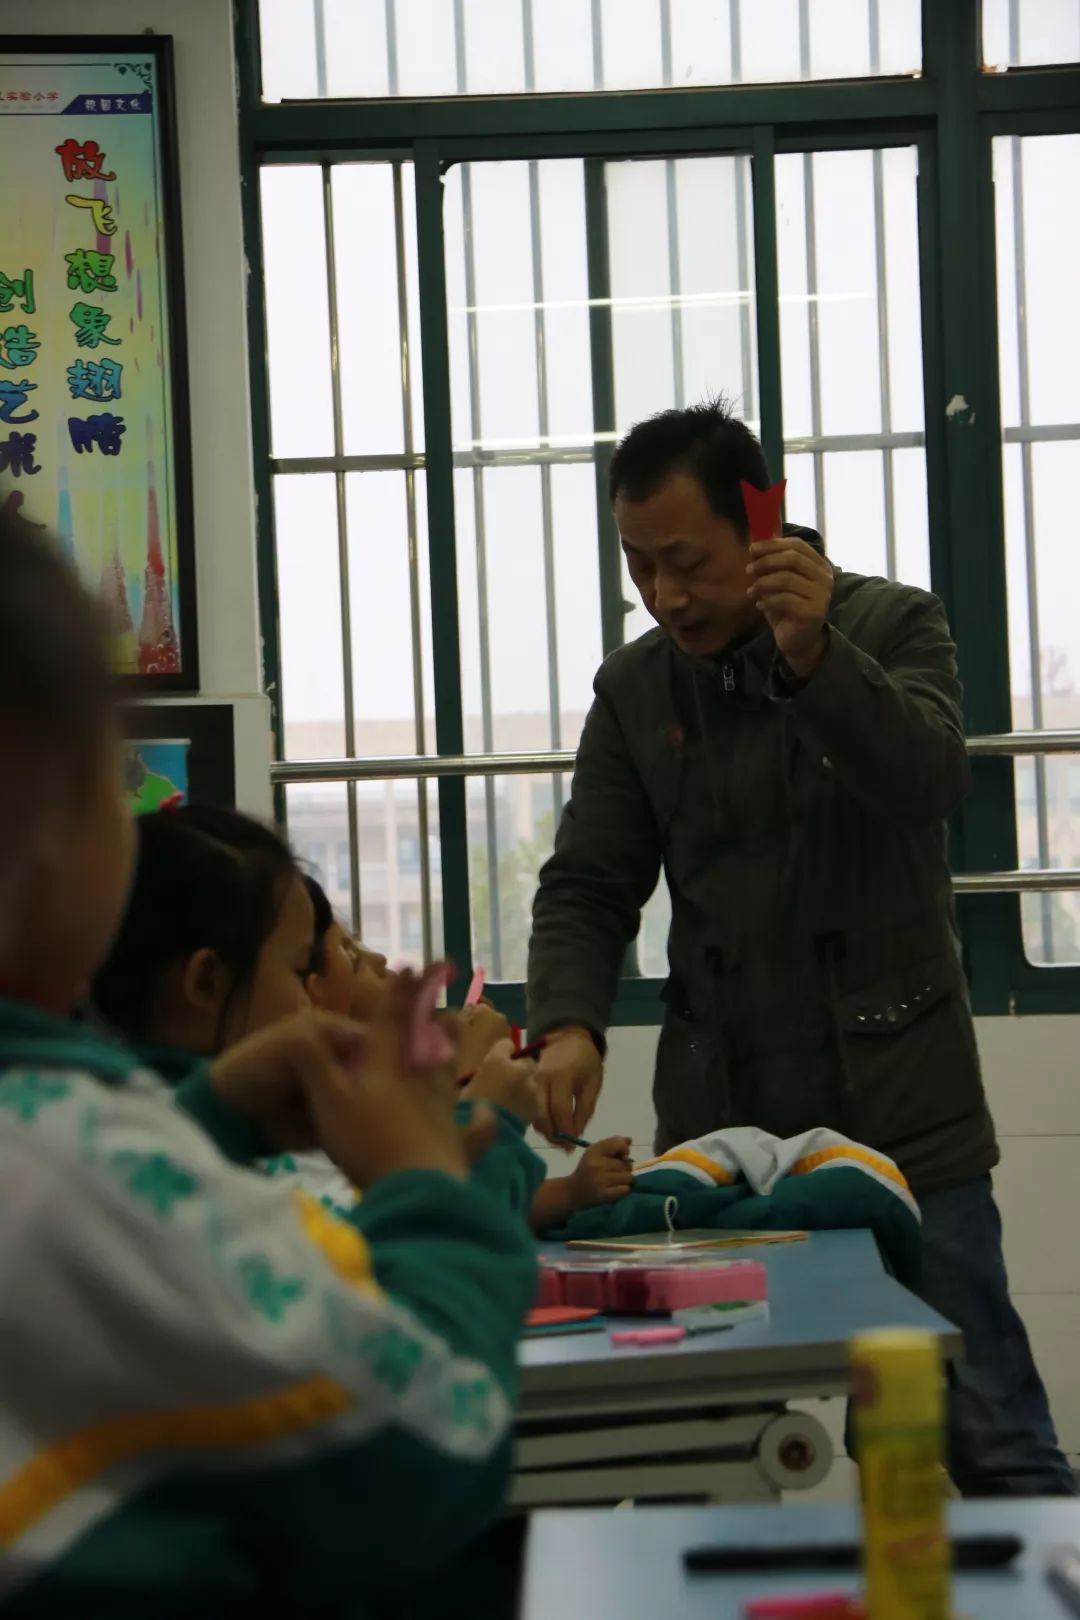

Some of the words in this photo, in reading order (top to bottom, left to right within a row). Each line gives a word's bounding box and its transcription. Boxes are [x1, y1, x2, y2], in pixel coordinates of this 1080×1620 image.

[55, 138, 127, 456] 放飞想象翅膀
